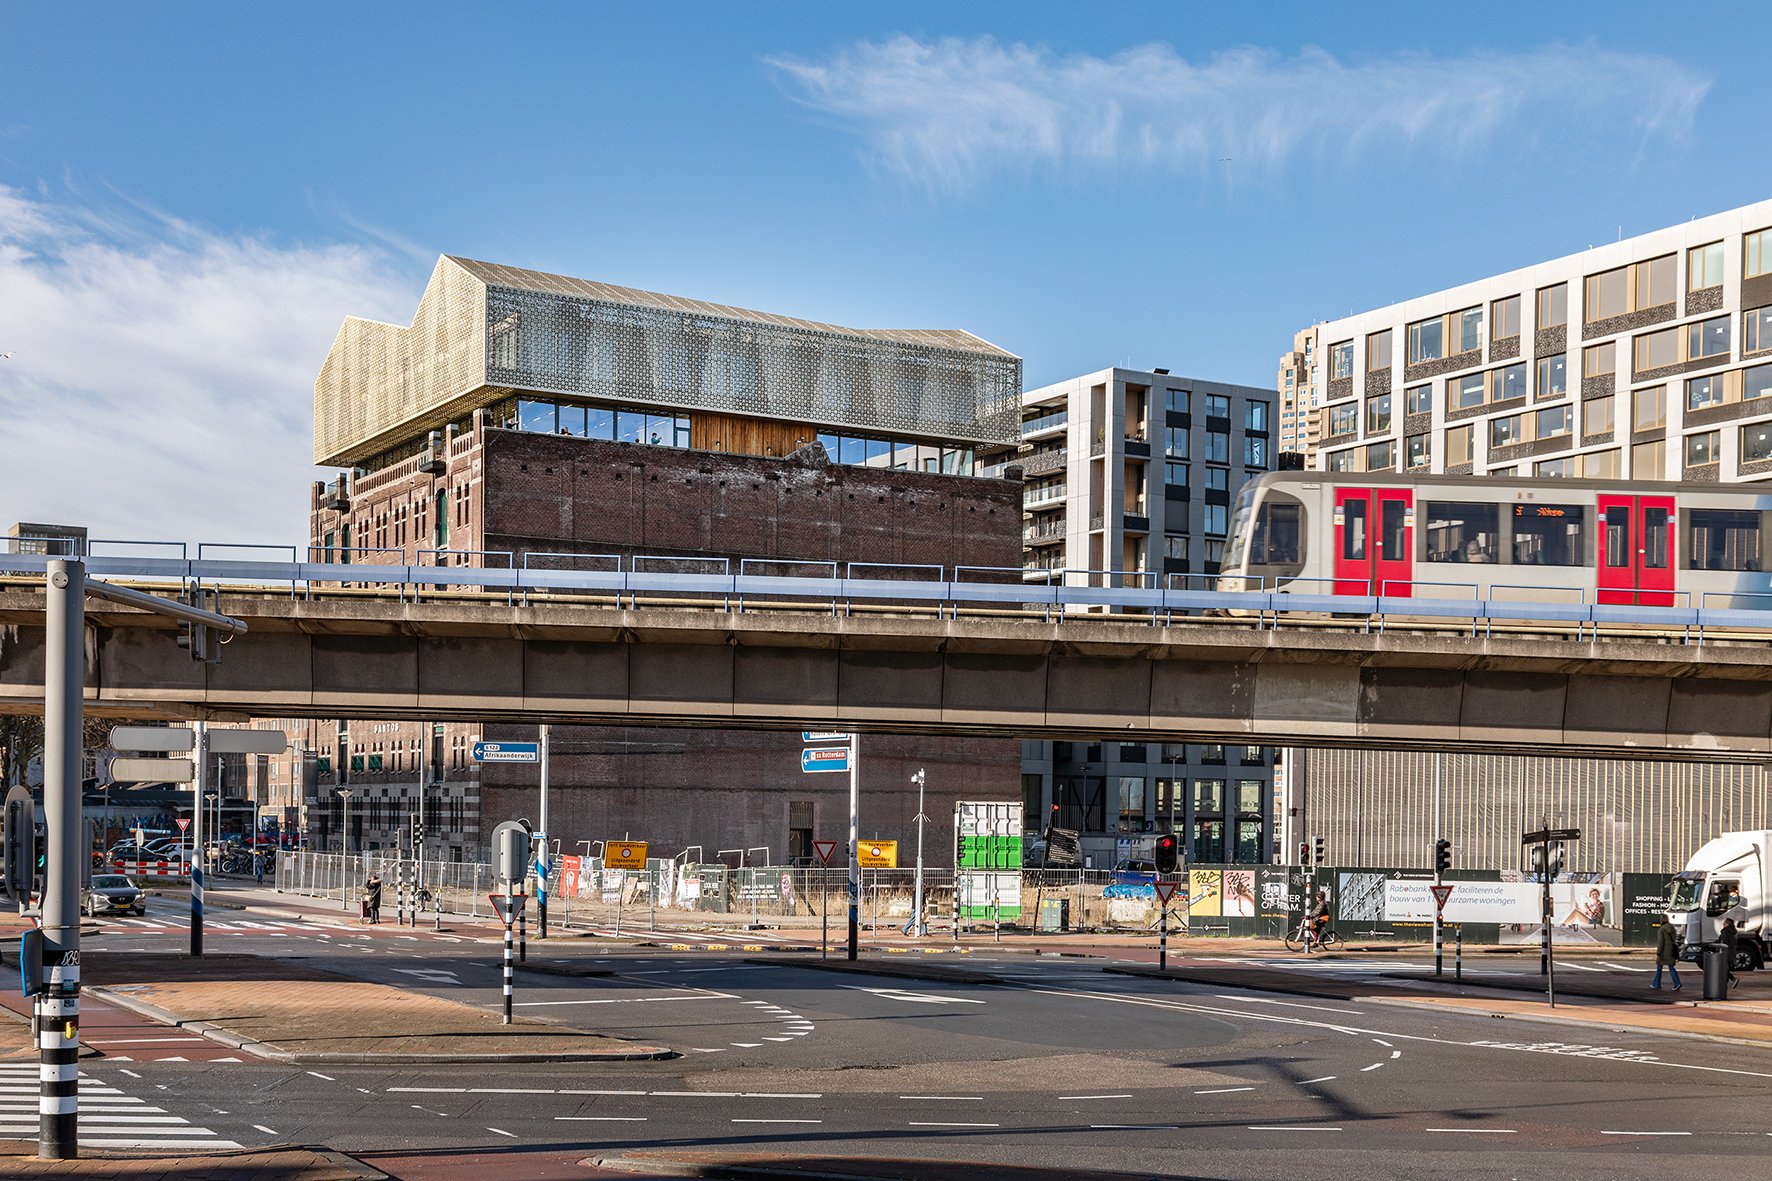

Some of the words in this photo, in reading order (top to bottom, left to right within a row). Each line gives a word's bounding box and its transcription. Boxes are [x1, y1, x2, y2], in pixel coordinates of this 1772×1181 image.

[373, 722, 399, 733] SANTOS
[484, 752, 533, 760] Afrikaanderwijk
[1389, 884, 1428, 893] Rabobank
[1457, 885, 1493, 895] faciliteren
[1494, 886, 1504, 895] de
[1389, 895, 1410, 903] bouw
[1479, 896, 1516, 906] woningen
